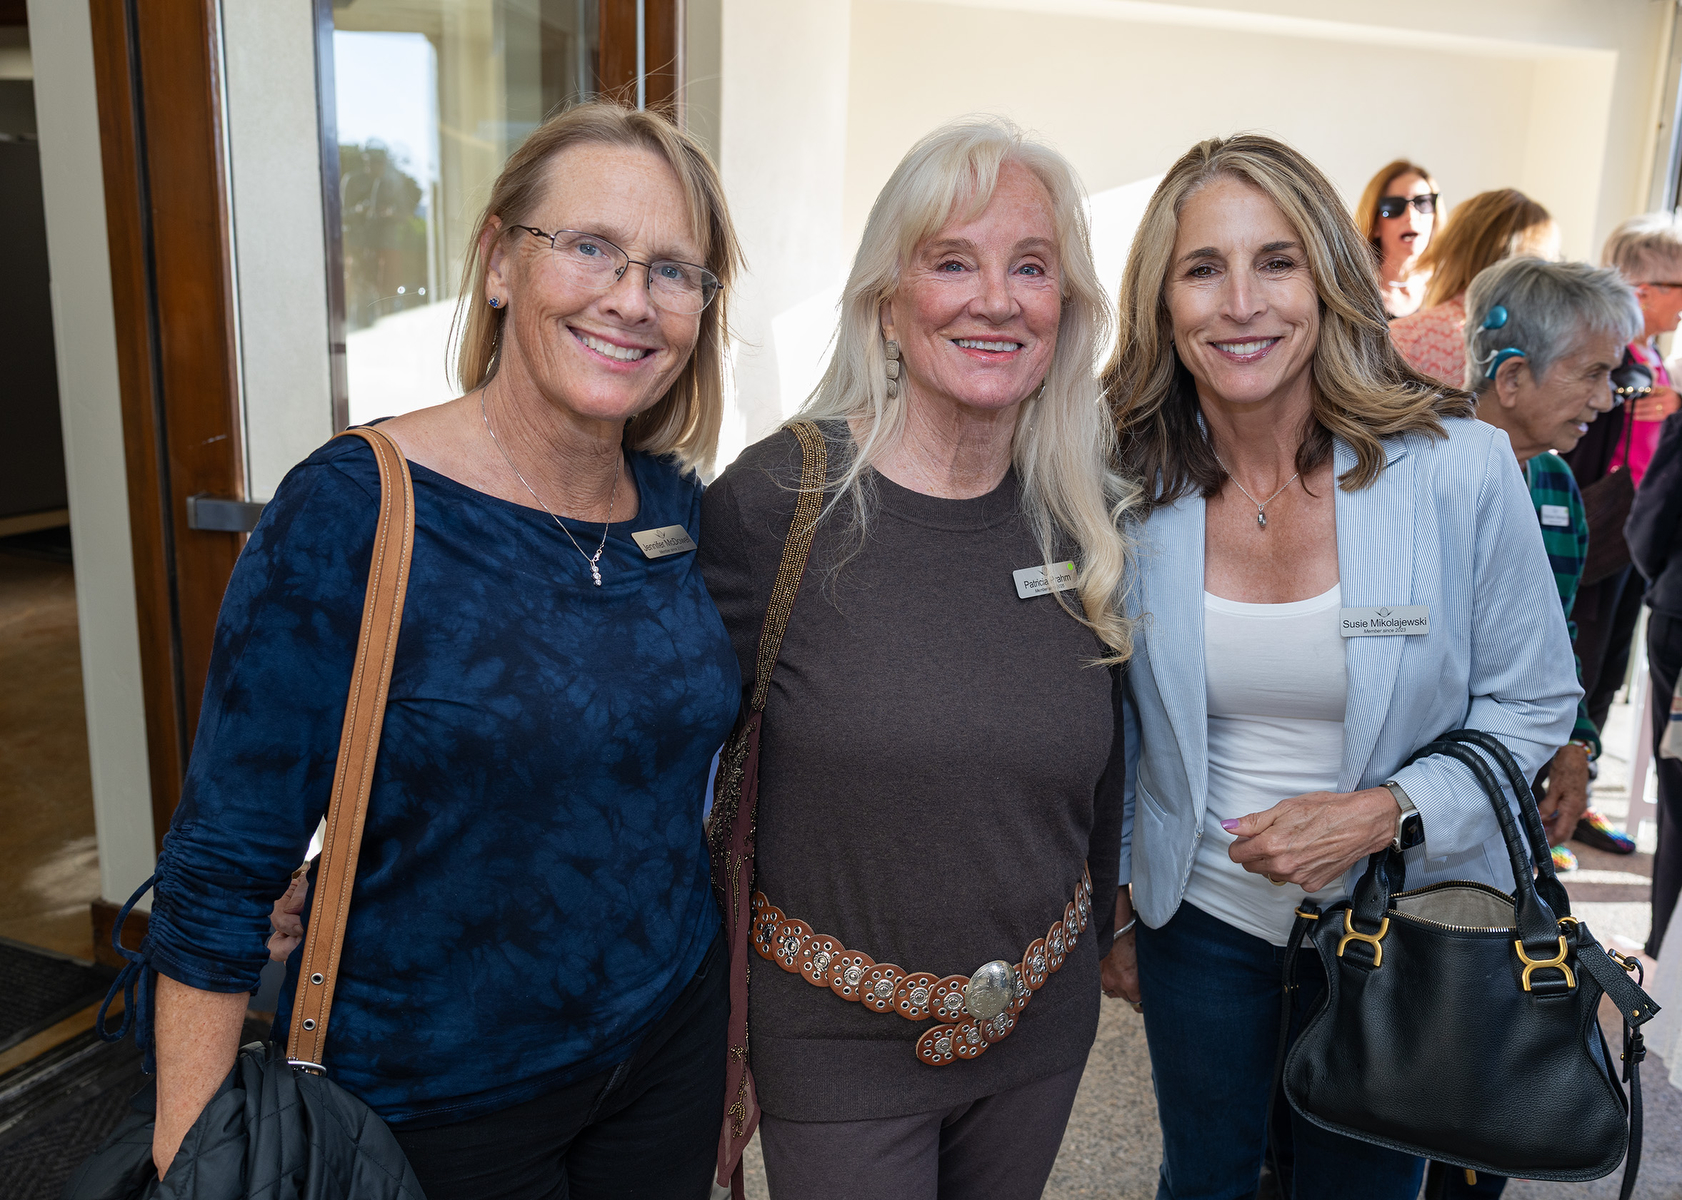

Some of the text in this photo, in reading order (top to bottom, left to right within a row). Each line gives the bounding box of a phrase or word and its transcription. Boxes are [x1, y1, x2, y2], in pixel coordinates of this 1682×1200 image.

[642, 540, 665, 551] Jennifer
[1023, 577, 1049, 589] Patricia
[1342, 616, 1427, 629] Susie Mikolajewski
